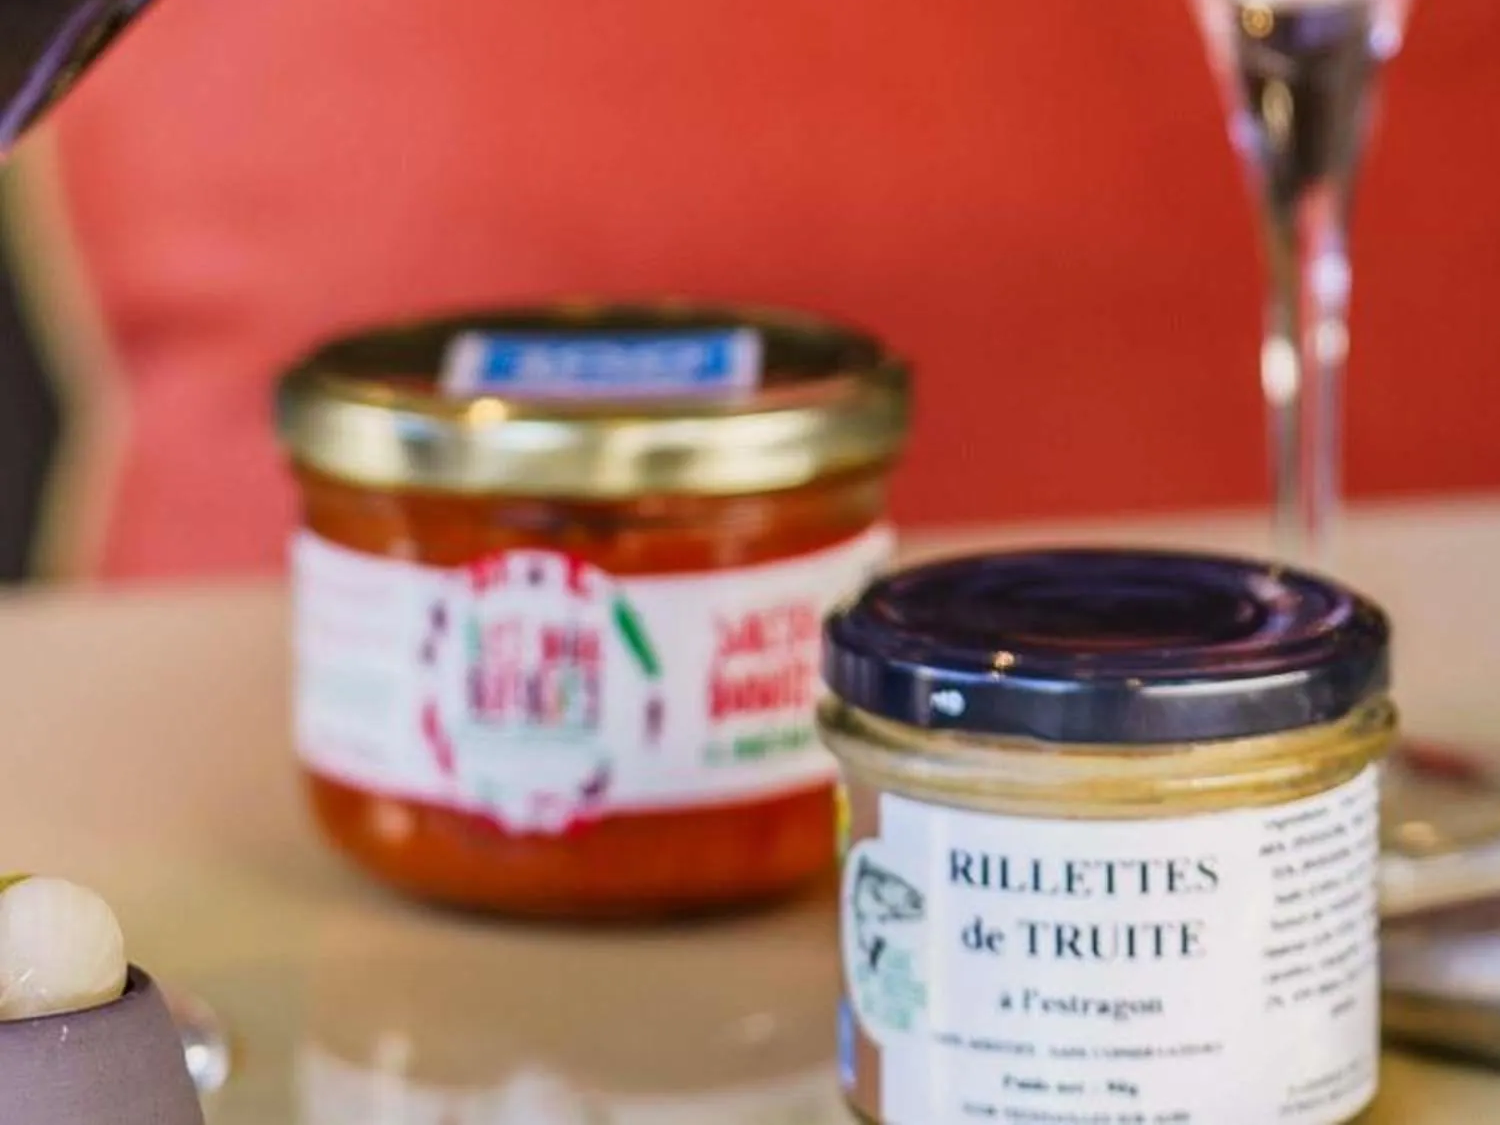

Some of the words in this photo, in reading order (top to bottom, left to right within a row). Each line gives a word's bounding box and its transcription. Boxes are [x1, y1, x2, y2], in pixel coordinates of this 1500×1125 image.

[948, 849, 1219, 895] RILLETTES
[961, 916, 1005, 953] de
[1017, 920, 1207, 960] TRUITE
[1023, 988, 1163, 1021] l'estragon
